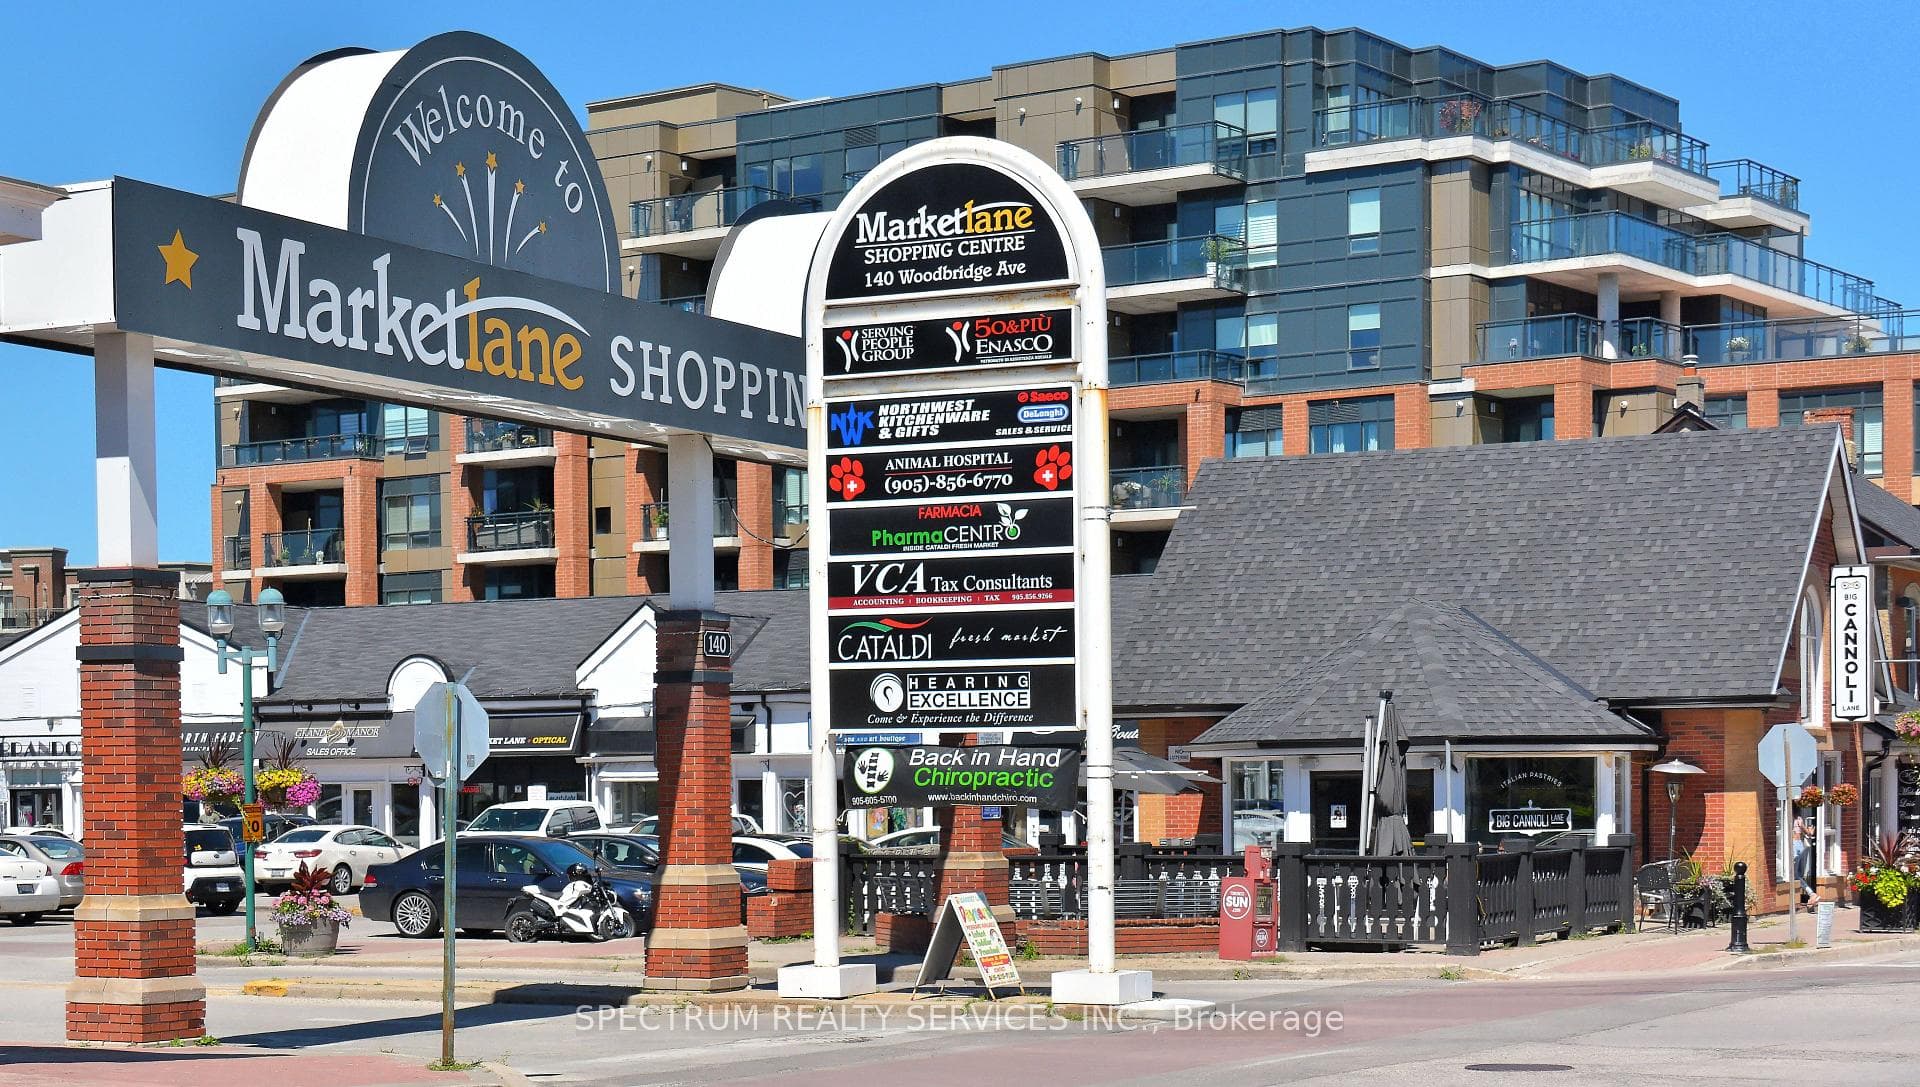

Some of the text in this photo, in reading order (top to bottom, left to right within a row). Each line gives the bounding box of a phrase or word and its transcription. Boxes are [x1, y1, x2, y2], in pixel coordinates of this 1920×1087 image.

[392, 85, 583, 214] Welcome to
[855, 200, 1034, 244] Marketlane
[864, 235, 1025, 264] SHOPPING CENTRE
[865, 260, 1026, 287] 140 Woodbridge Ave
[236, 227, 588, 391] Marketlane
[861, 325, 914, 338] SERVING
[862, 336, 914, 350] PEOPLE
[976, 334, 1053, 355] ENASCO
[861, 348, 914, 362] GROUP
[1029, 391, 1069, 402] Saeco
[878, 400, 975, 416] NORTHWEST
[1023, 408, 1063, 419] DeLonghi
[879, 410, 990, 428] KITCHENWARE
[878, 425, 940, 439] & GIFTS
[995, 426, 1023, 436] SALES
[885, 453, 1013, 471] ANIMAL HOSPITAL
[885, 473, 1013, 494] (905)-856-6770
[918, 504, 981, 519] FARMACIA
[851, 561, 1053, 594] VCA Tax Consultants
[853, 597, 904, 606] ACCOUNTING
[916, 595, 972, 604] BOOKKEEPING
[708, 637, 727, 653] 140
[838, 626, 1068, 660] CATALDI fresh market
[1843, 603, 1858, 702] CANNOLI
[910, 675, 1029, 690] HEARING
[911, 692, 1028, 708] EXCELLENCE
[867, 712, 1033, 725] Come & Experience the Difference
[346, 727, 379, 737] MANOR
[909, 748, 1061, 768] Back in Hand
[914, 767, 1054, 790] Chiropractic
[1500, 772, 1562, 789] ITALIAN PASTRIES
[928, 792, 1037, 804] www.backinhandchiro.com
[1496, 814, 1510, 828] BIG
[1513, 814, 1549, 828] CANNOLI
[1226, 896, 1248, 907] SUN
